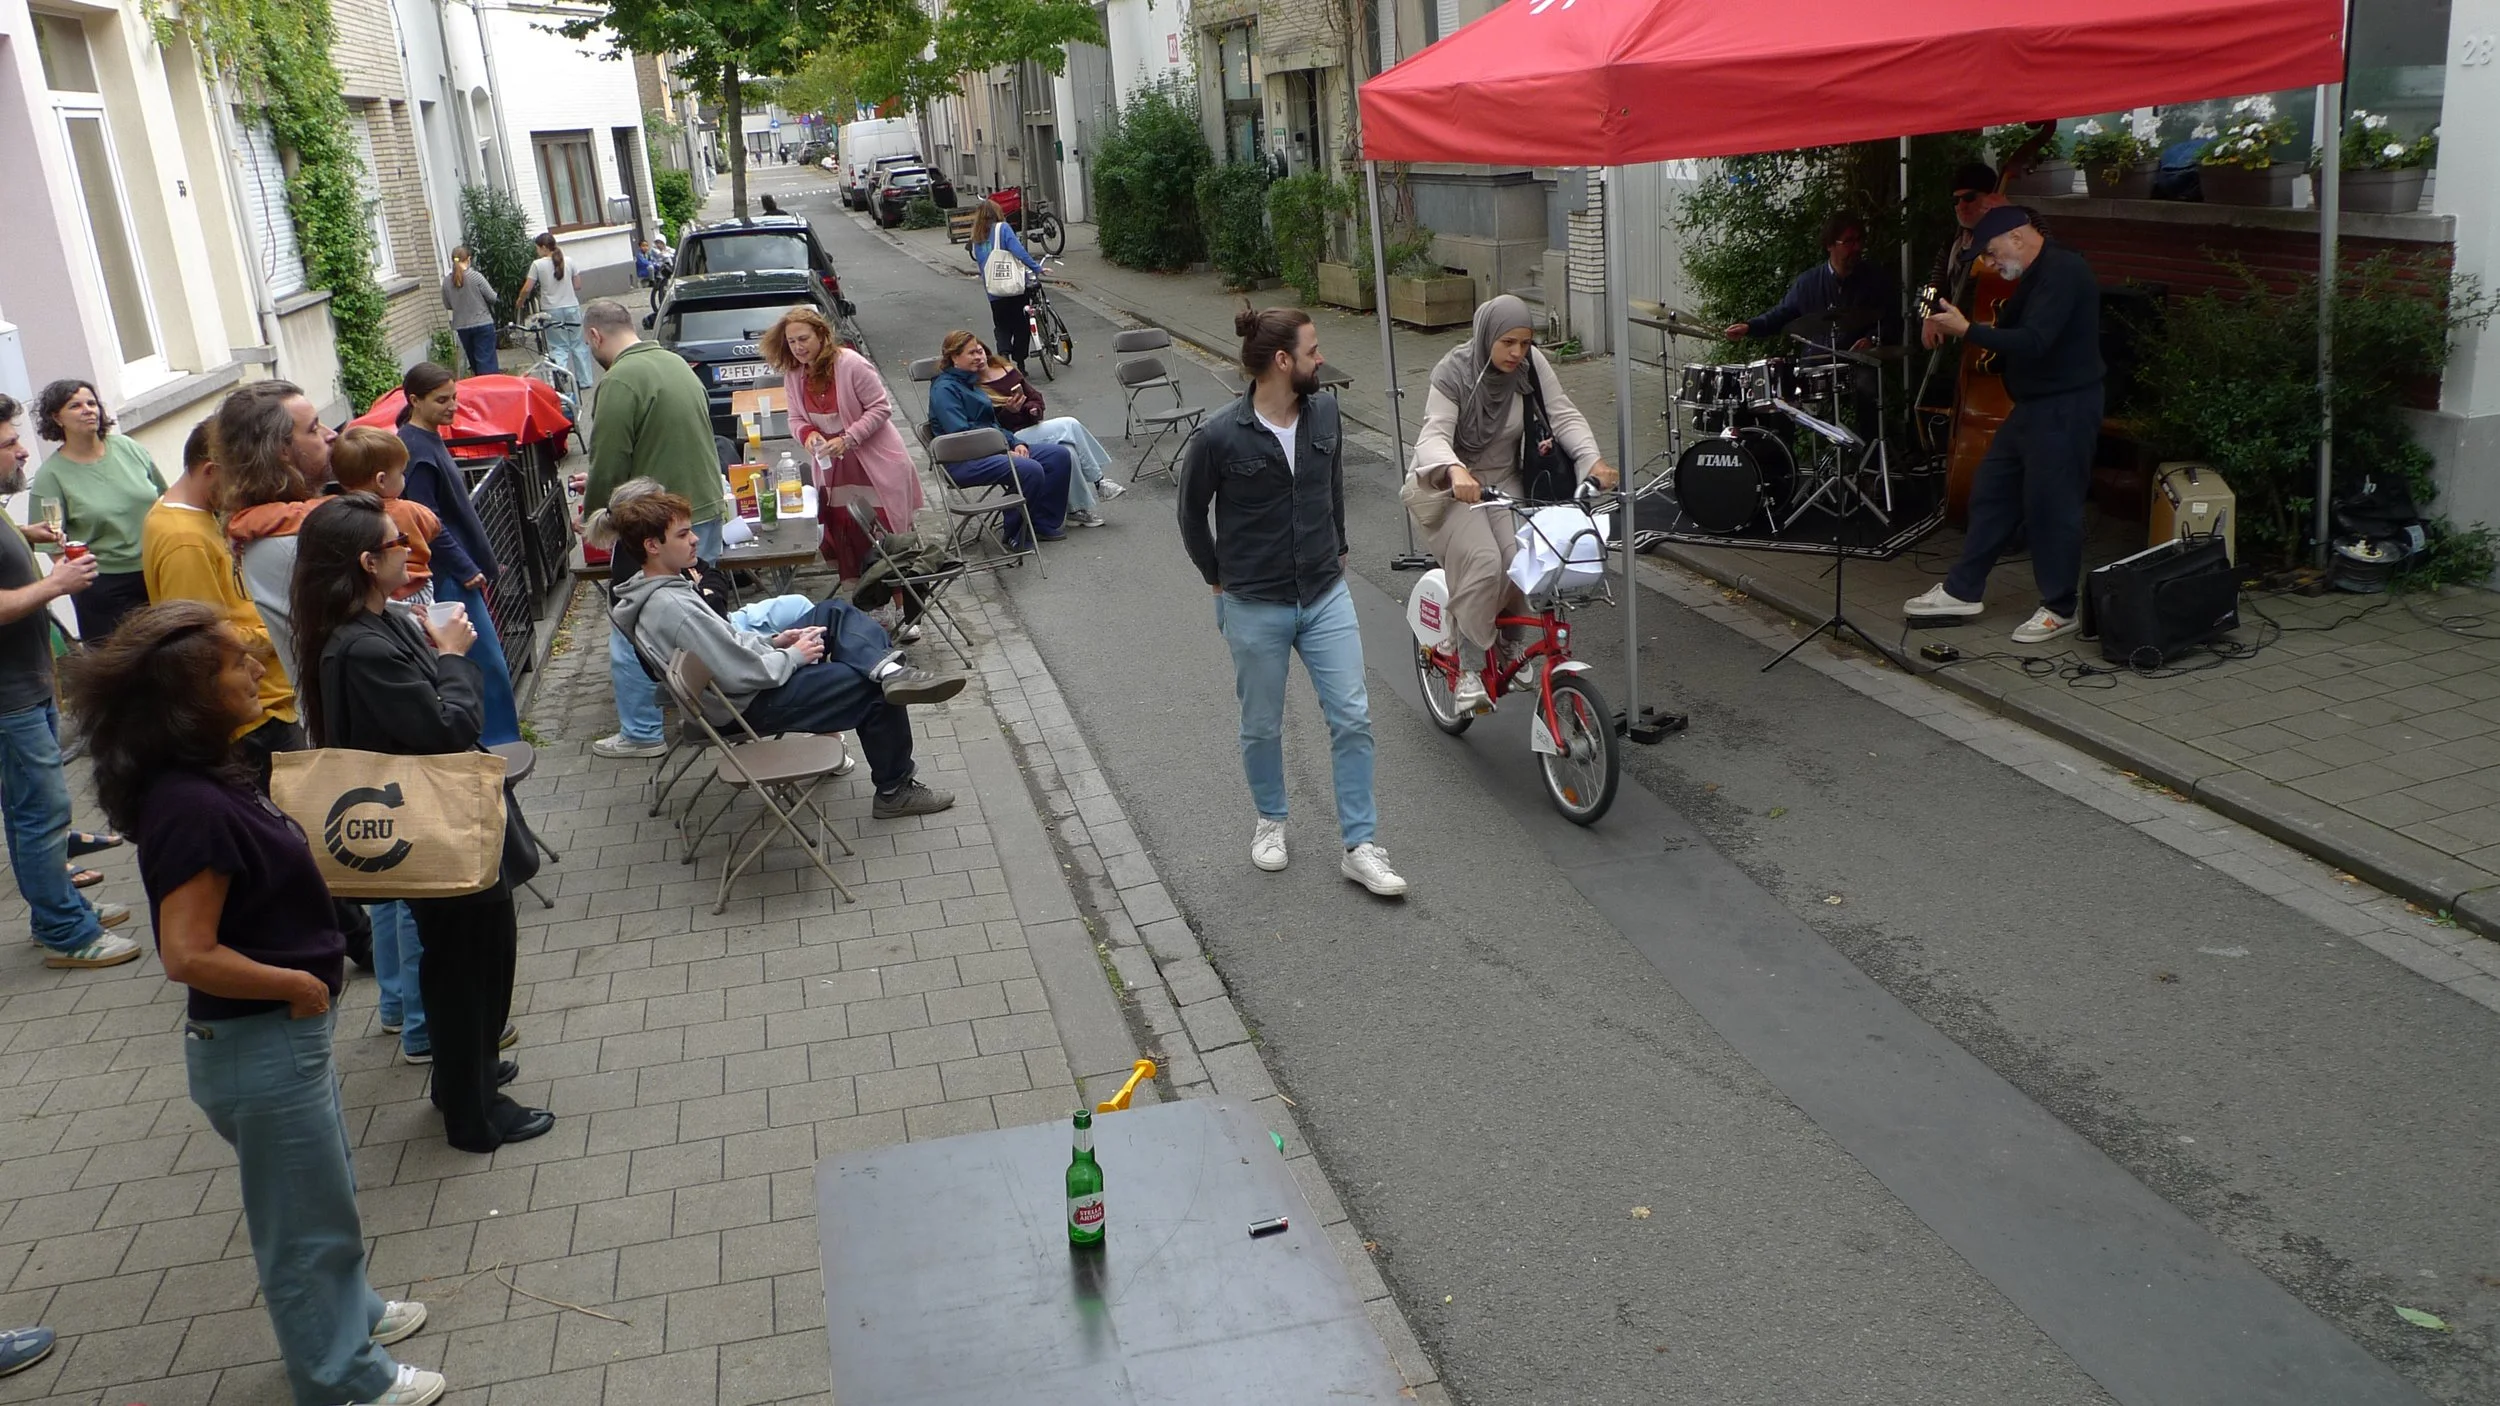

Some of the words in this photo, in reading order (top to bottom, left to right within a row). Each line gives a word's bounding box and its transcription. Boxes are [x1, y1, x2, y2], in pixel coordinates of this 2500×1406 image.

[2461, 37, 2493, 67] 28
[721, 364, 771, 378] 2-FEV-2
[1704, 454, 1740, 467] TAMA
[346, 819, 394, 840] CRU
[1080, 1206, 1102, 1216] STELLA
